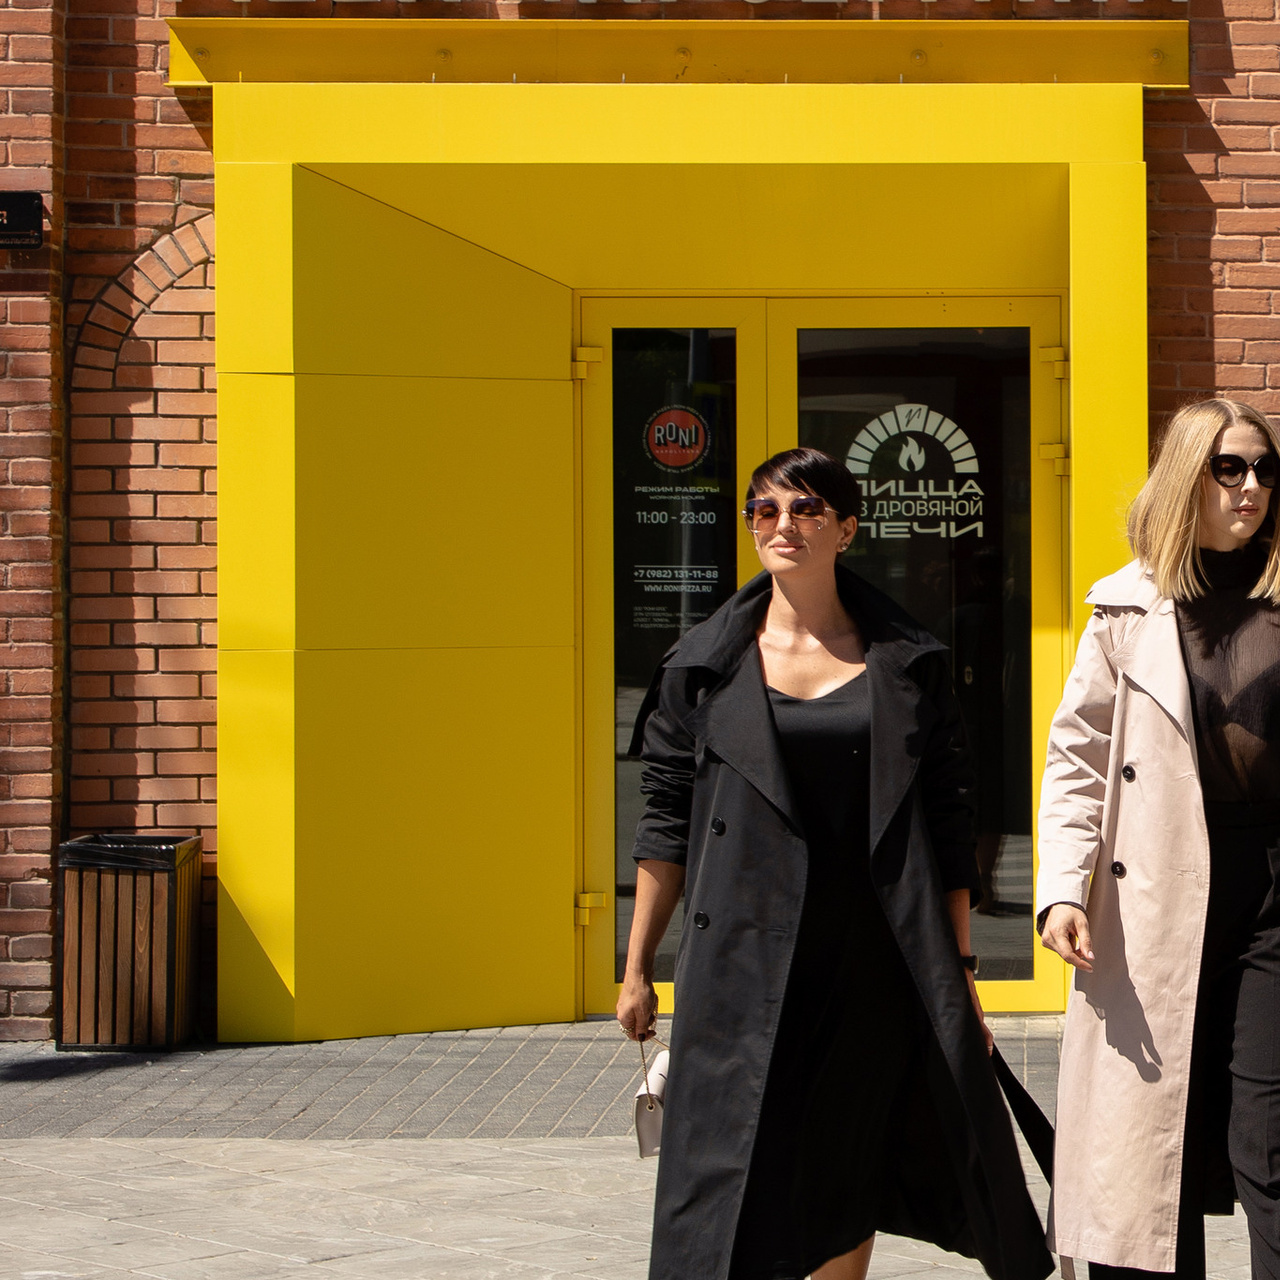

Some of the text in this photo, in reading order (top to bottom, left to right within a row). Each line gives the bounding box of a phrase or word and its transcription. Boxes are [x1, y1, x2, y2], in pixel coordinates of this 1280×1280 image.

[654, 422, 697, 447] RONI
[873, 496, 983, 519] ДРОВЯНОЙ
[636, 511, 669, 524] 11:00
[680, 511, 716, 524] 23:00
[633, 569, 719, 579] +7 (982) 131-11-88
